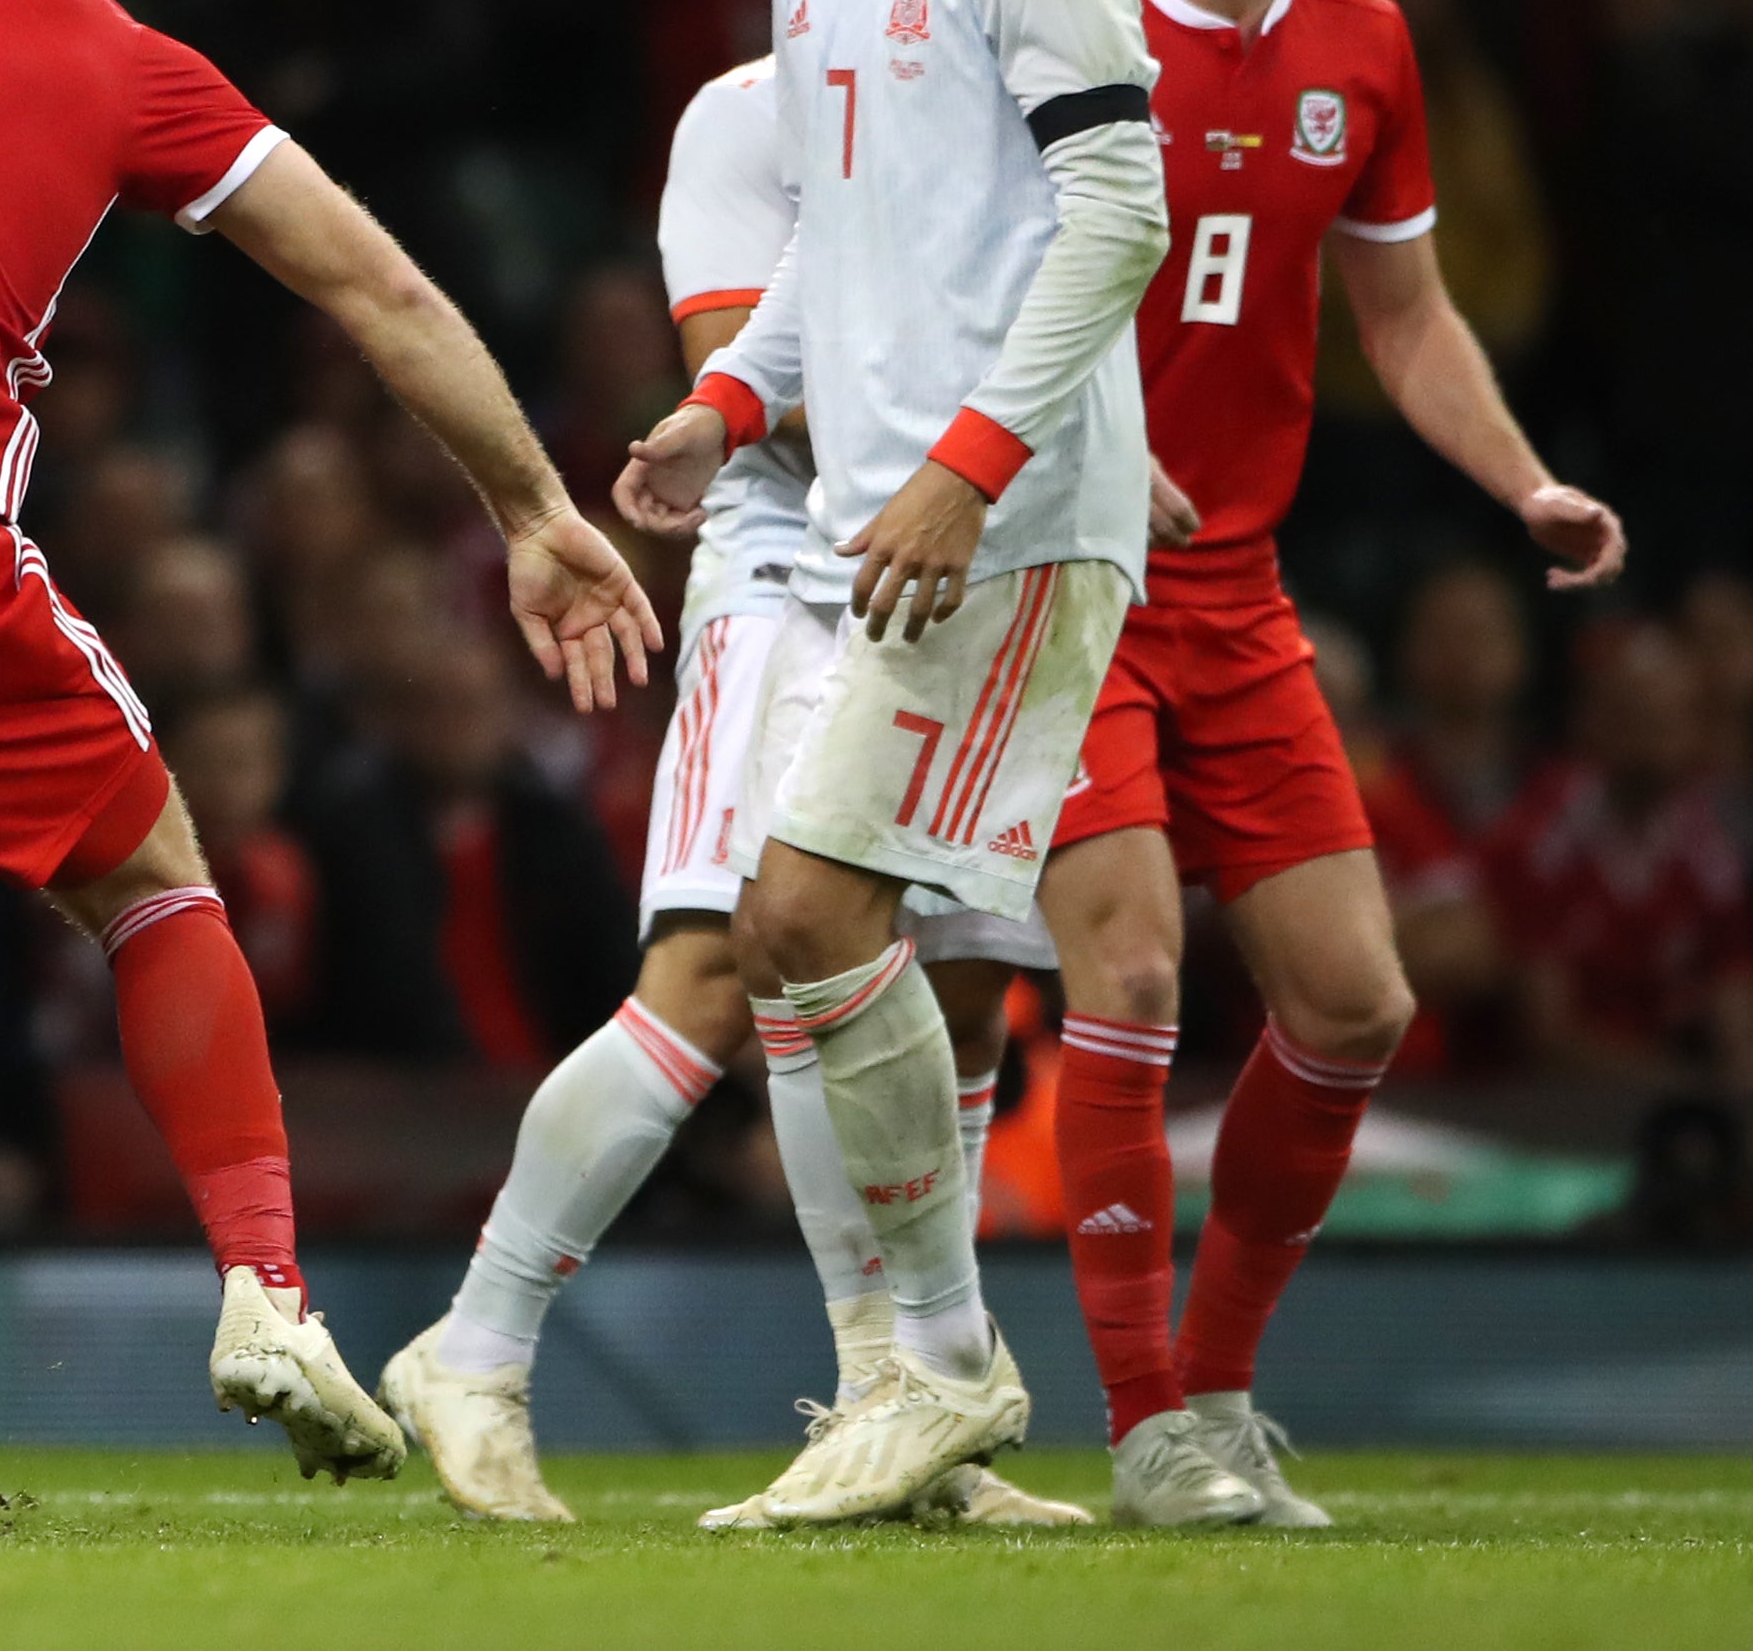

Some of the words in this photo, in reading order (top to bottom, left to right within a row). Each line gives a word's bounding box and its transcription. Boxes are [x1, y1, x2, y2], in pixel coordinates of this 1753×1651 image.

[826, 69, 857, 179] 7
[1180, 215, 1253, 326] 8
[892, 710, 945, 828] 7
